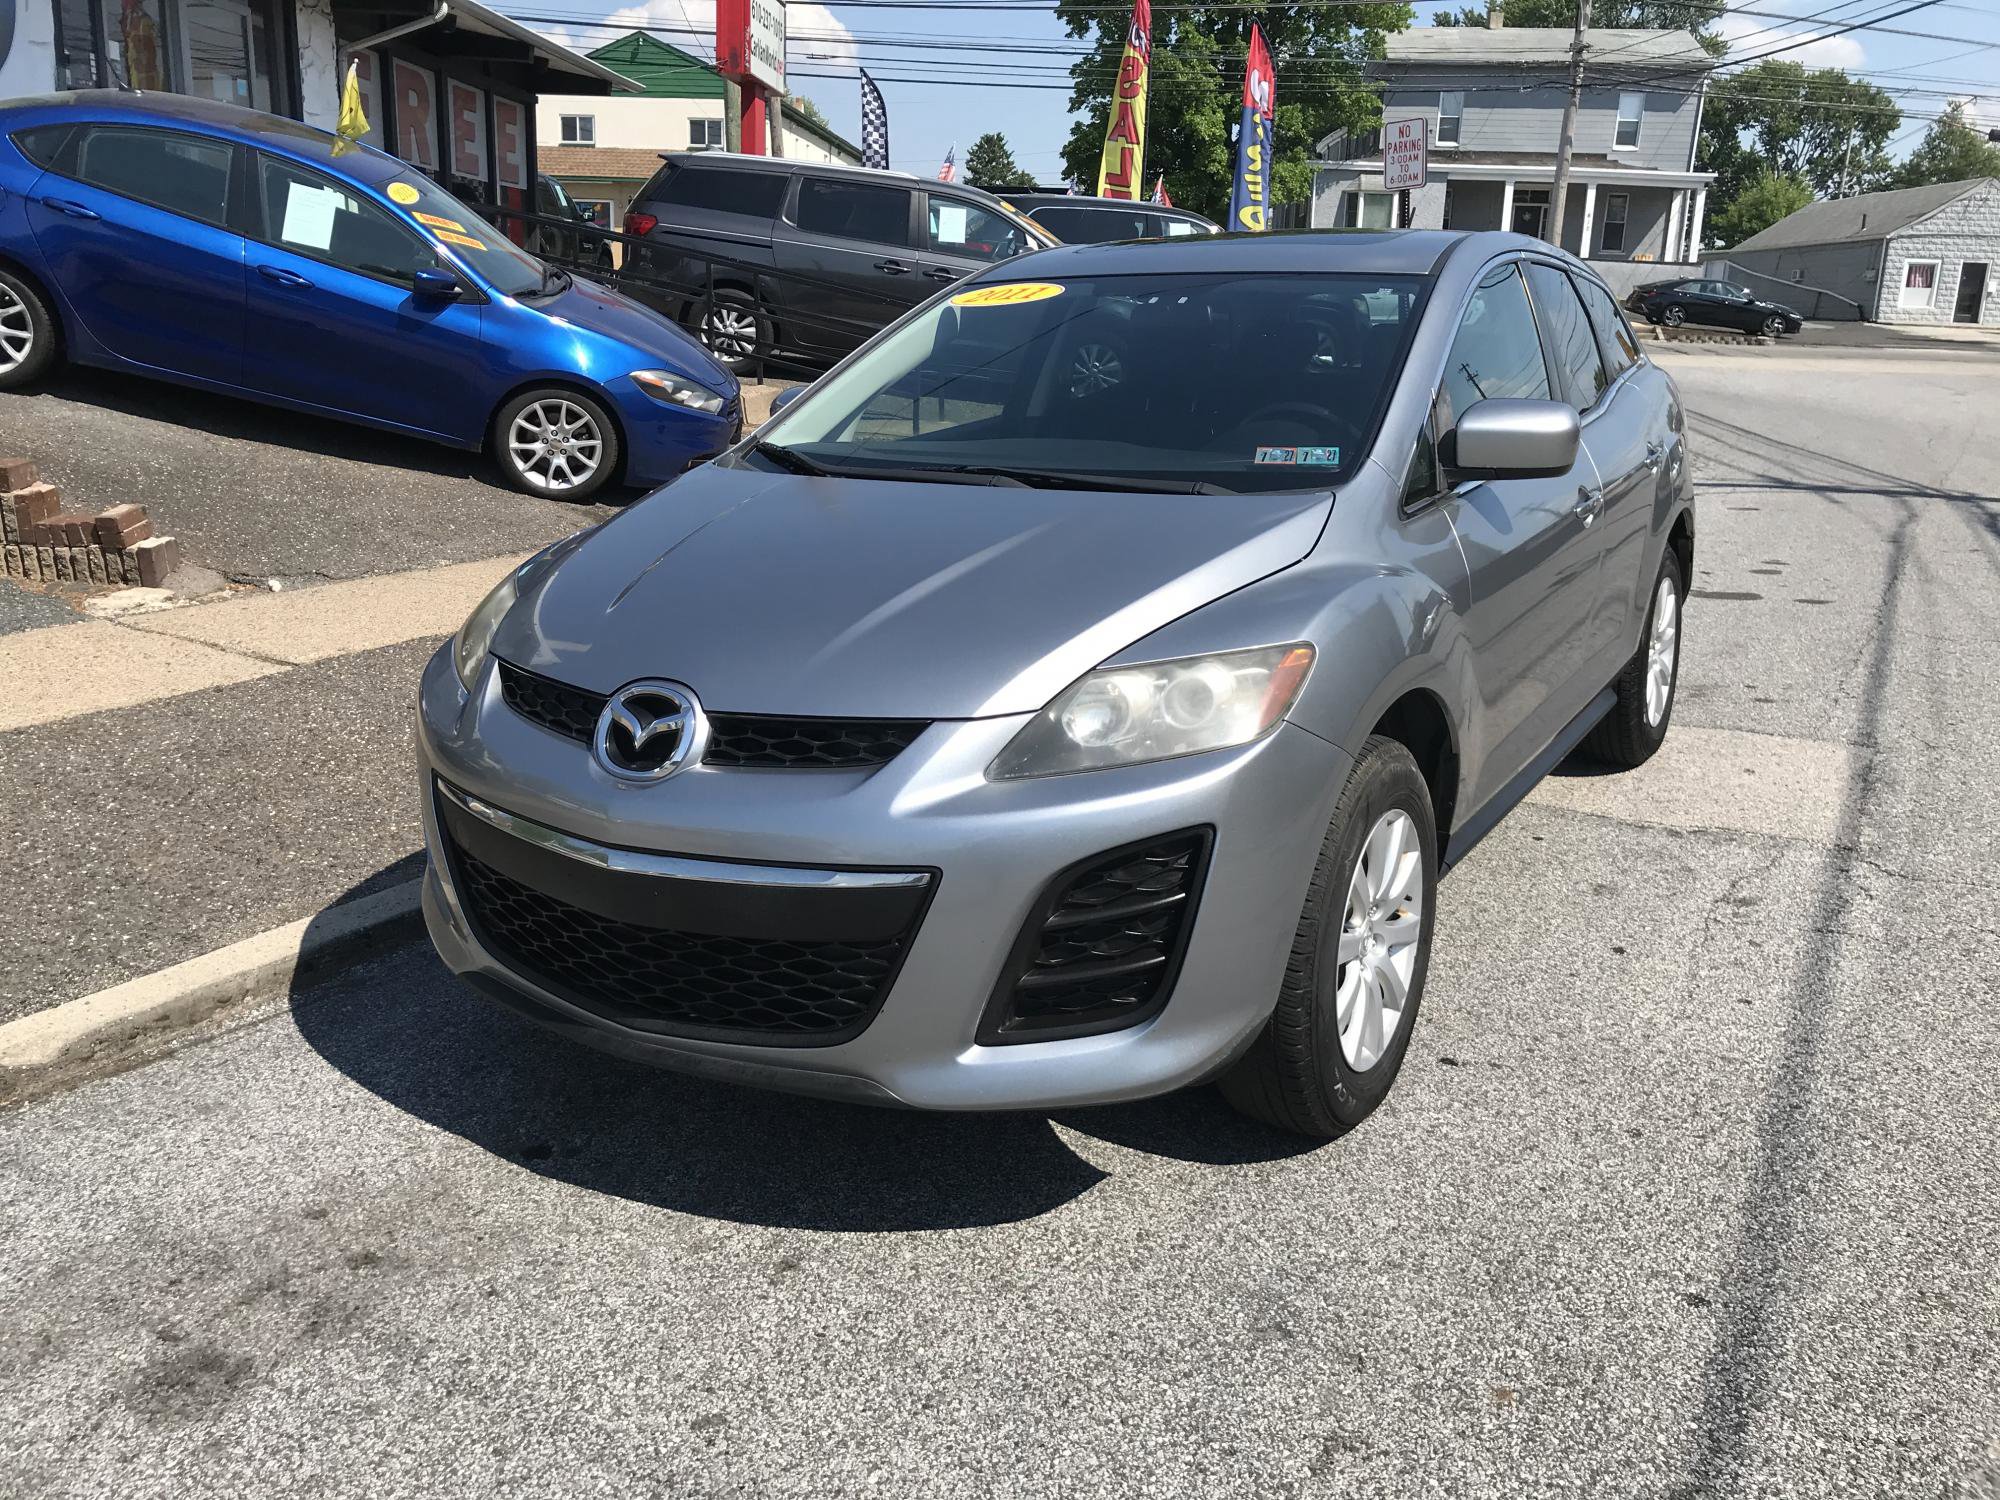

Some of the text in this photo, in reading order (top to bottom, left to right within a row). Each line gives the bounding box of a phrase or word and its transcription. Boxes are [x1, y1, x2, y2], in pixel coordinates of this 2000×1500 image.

[1398, 124, 1411, 138] NO
[1388, 138, 1421, 155] PARKING
[1400, 164, 1409, 173] TO
[960, 286, 1050, 303] 2011
[1261, 449, 1294, 462] 7 27
[1303, 449, 1336, 462] 7 27
